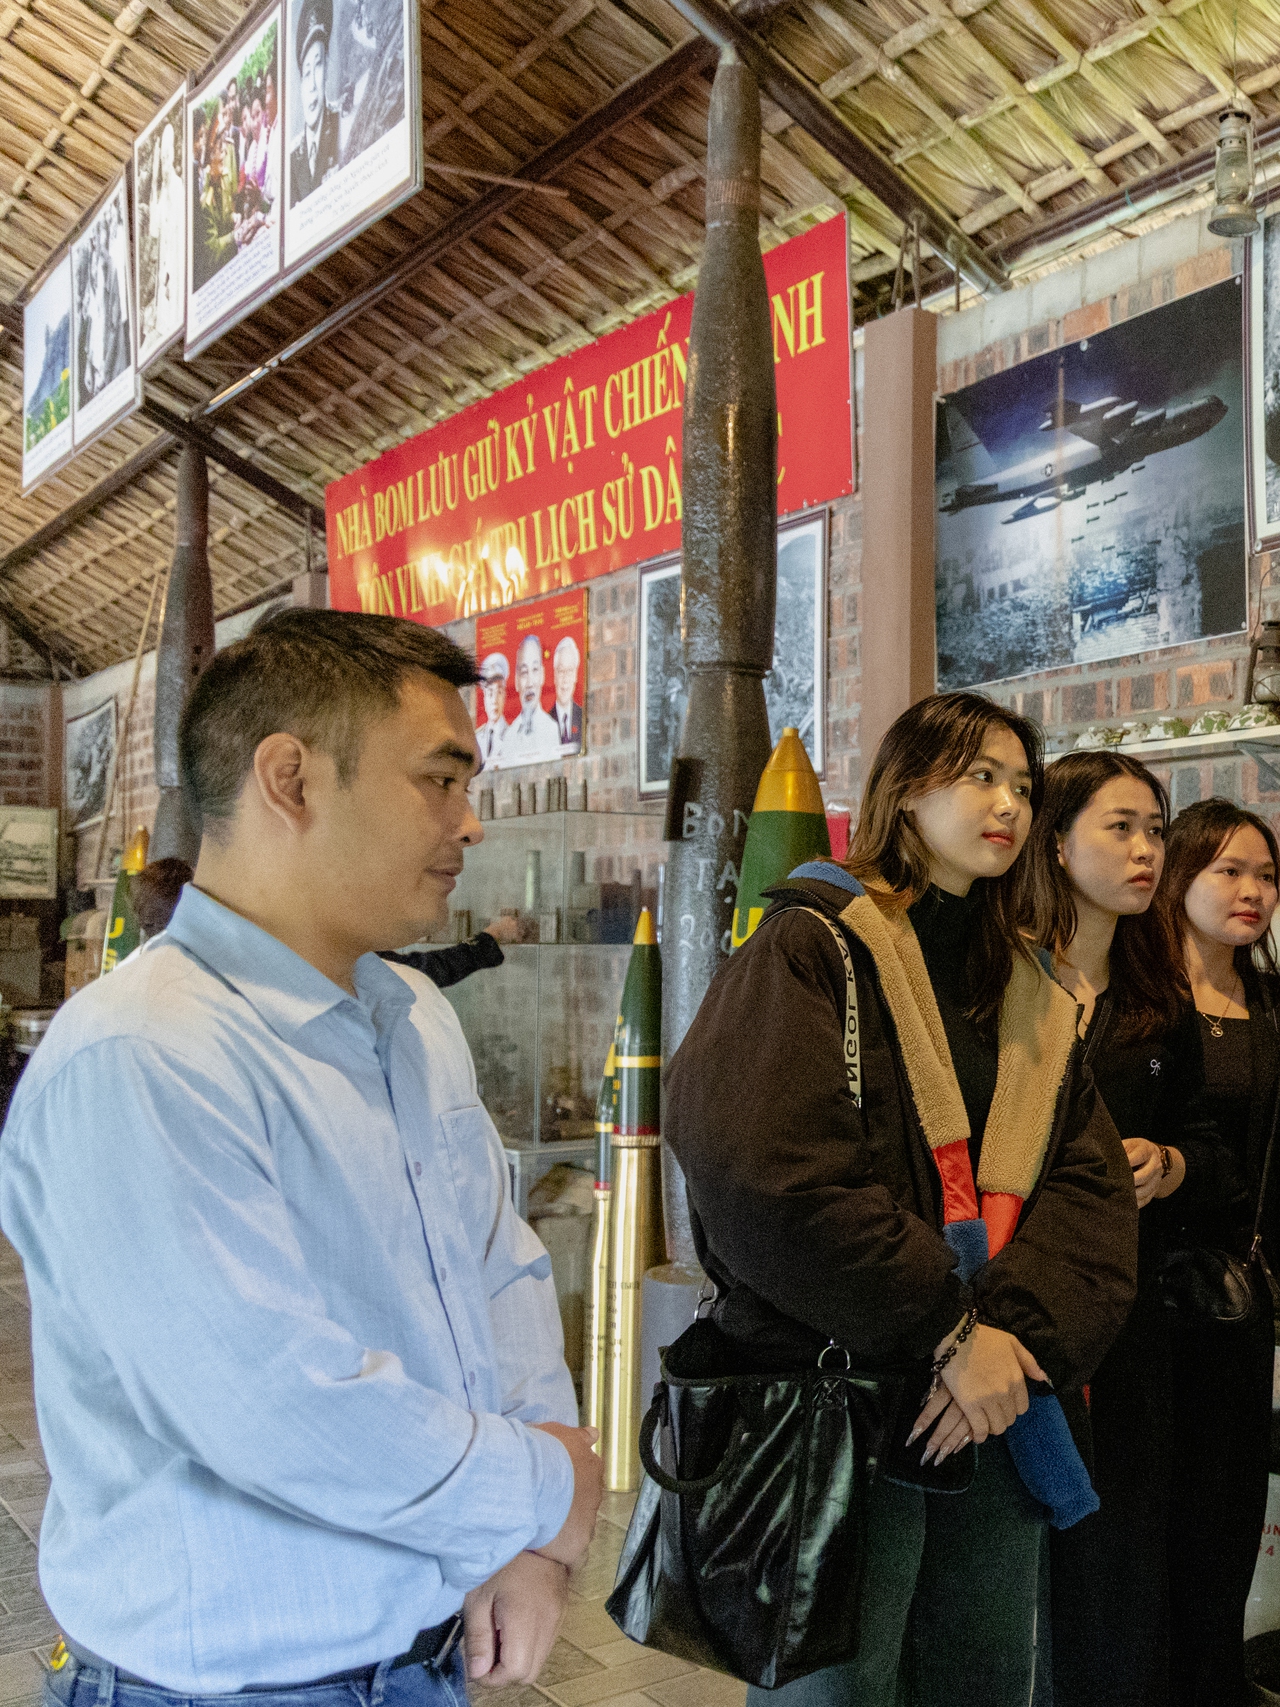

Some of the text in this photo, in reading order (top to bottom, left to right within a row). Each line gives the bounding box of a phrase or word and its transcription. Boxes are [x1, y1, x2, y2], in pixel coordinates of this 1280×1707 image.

[335, 485, 373, 560] NHÀ
[373, 475, 415, 543] BOM
[416, 450, 459, 522] LƯU
[503, 393, 538, 482] KỶ
[542, 376, 598, 474] VẬT
[604, 311, 690, 439] CHIẾN
[532, 488, 598, 580] LỊCH
[602, 452, 634, 546] SỬ
[639, 435, 683, 531] DÂ
